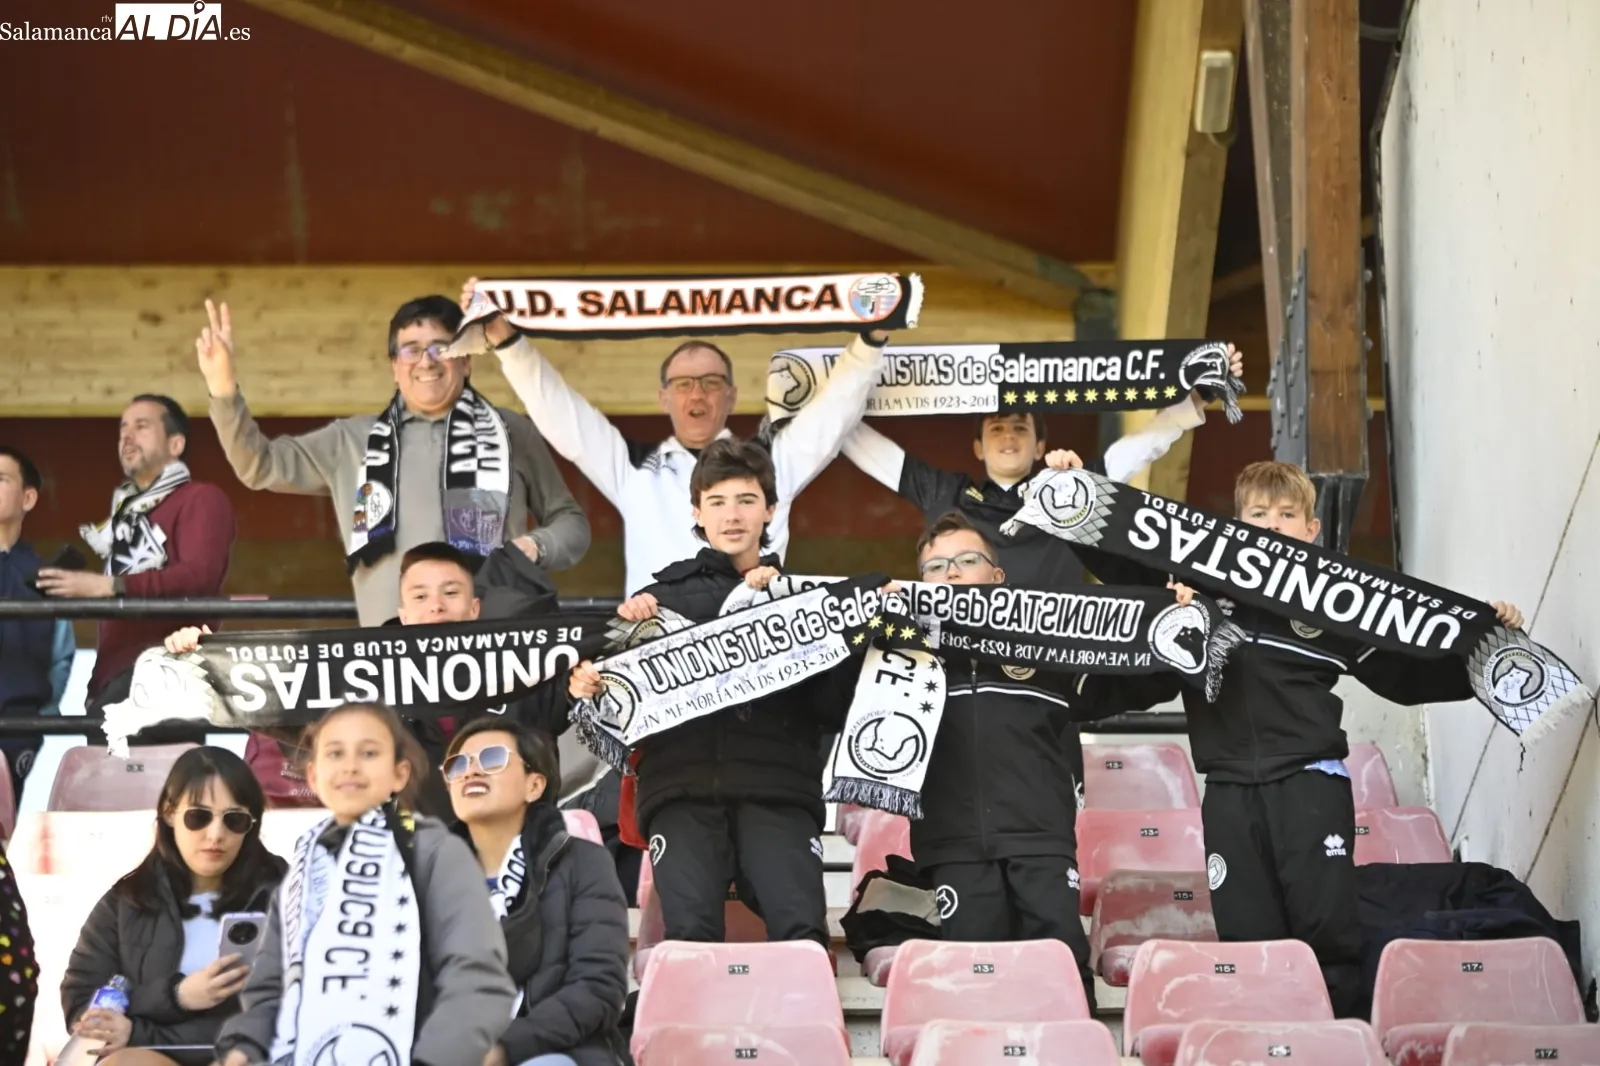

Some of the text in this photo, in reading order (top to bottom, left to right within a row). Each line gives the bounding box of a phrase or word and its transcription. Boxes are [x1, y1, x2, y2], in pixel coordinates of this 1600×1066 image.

[486, 283, 842, 318] U.D. SALAMANCA
[957, 355, 988, 387] de
[992, 350, 1121, 387] Salamanca
[1125, 349, 1166, 381] C.F.
[1127, 506, 1461, 650] UNIONISTAS
[1140, 491, 1478, 621] DE SALAMANCA CLUB DE FÚTBOL
[226, 626, 583, 665] DE SALAMANCA CLUB DE FÚTBOL
[229, 644, 581, 712] UNIONISTAS
[638, 613, 787, 695] UNIONISTAS
[790, 608, 827, 645] de
